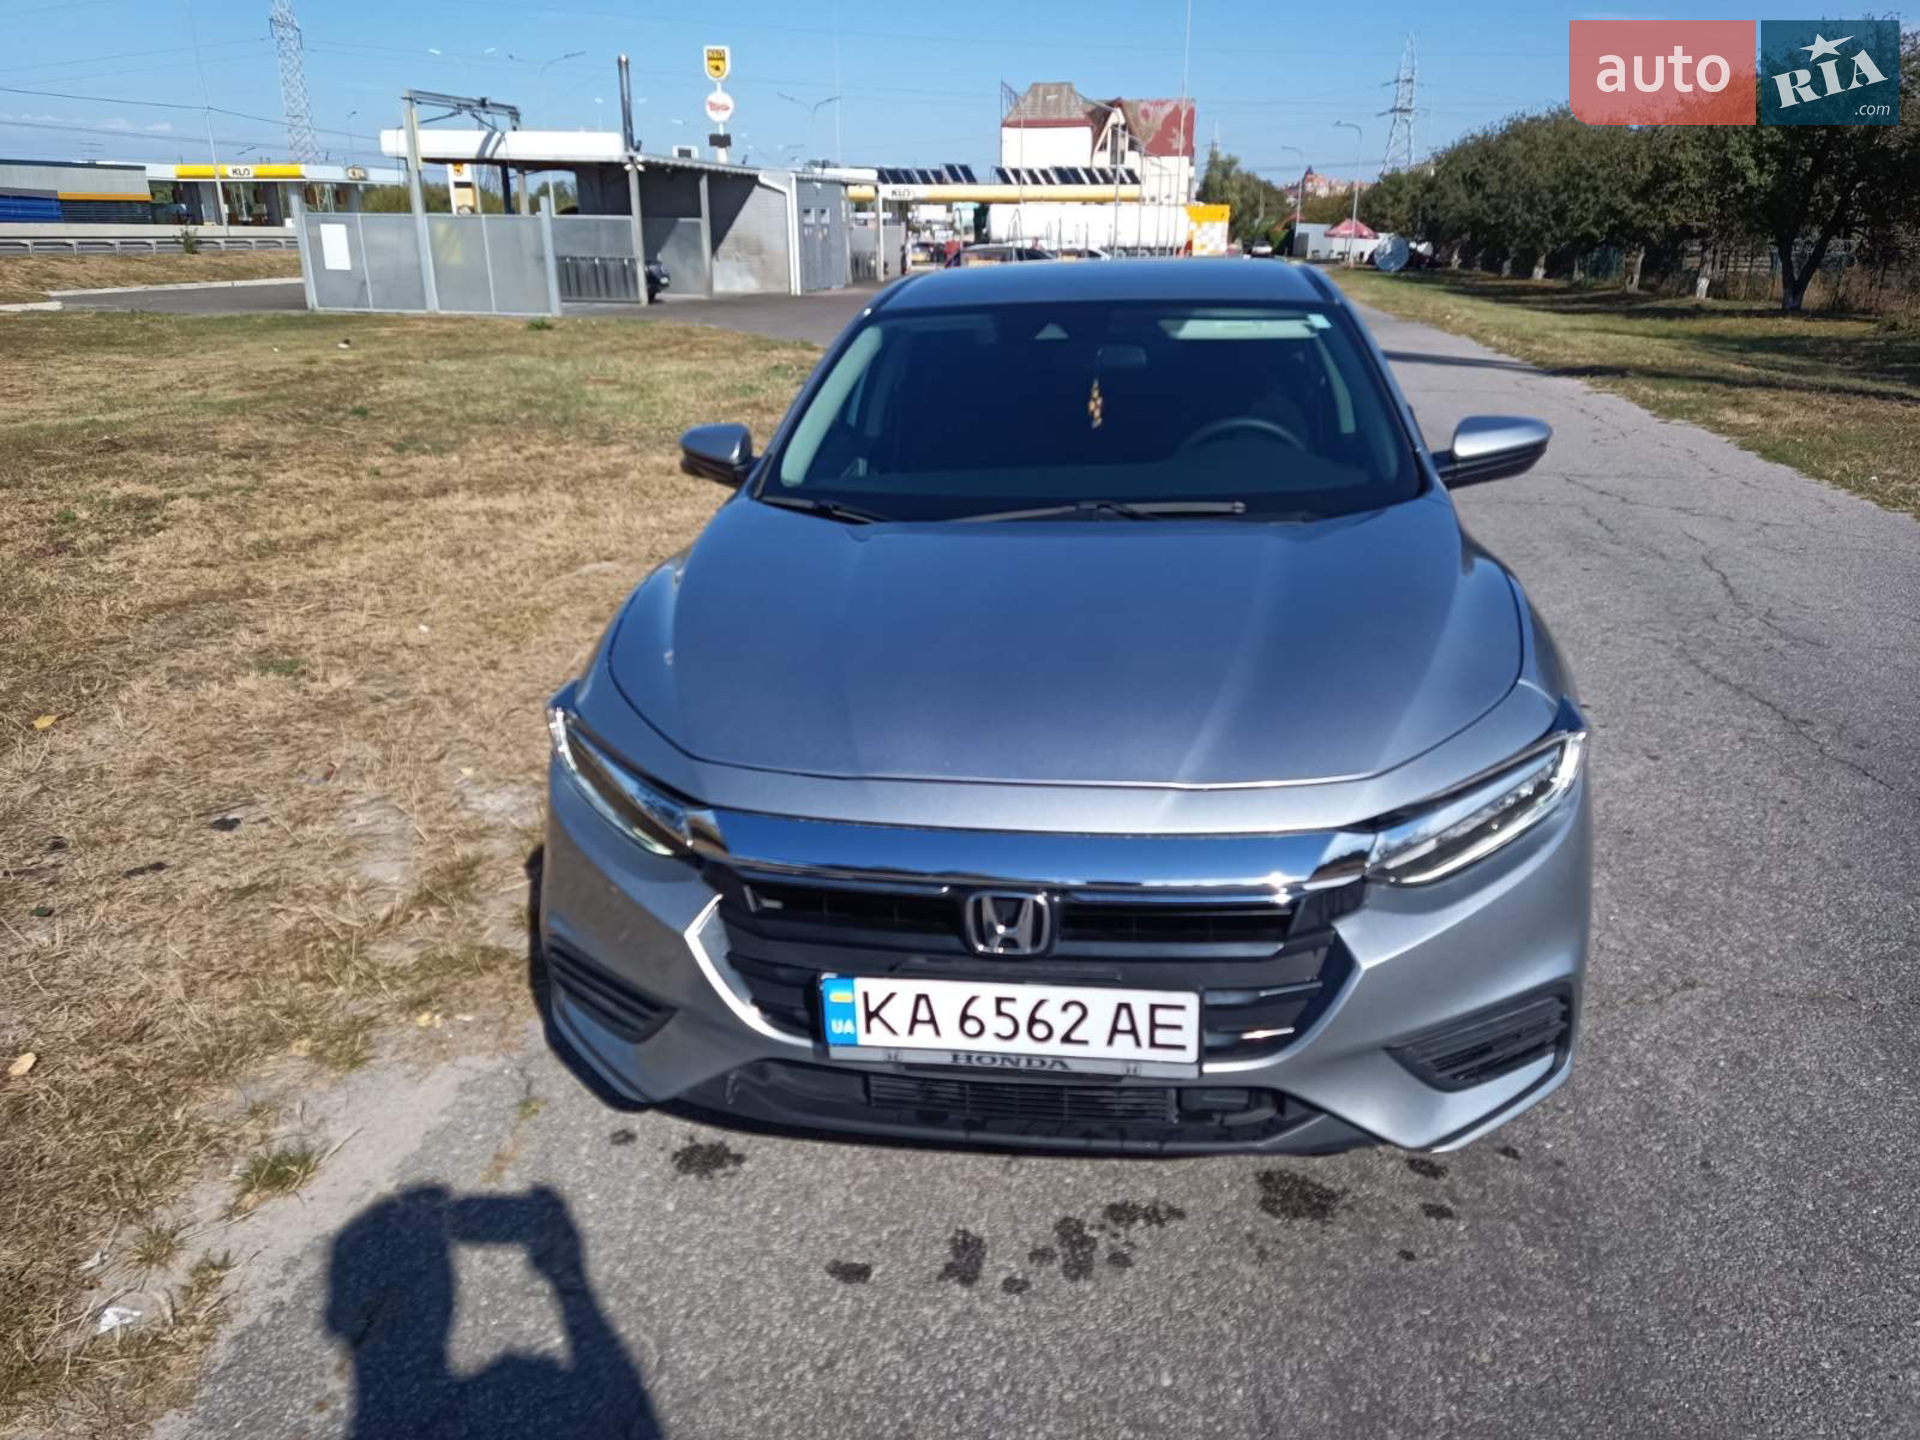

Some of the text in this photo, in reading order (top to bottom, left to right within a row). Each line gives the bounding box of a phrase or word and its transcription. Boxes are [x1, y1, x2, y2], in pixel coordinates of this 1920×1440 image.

[831, 1019, 855, 1034] UA
[862, 990, 1187, 1051] KA 6562 AE
[951, 1053, 1071, 1070] HONDA
